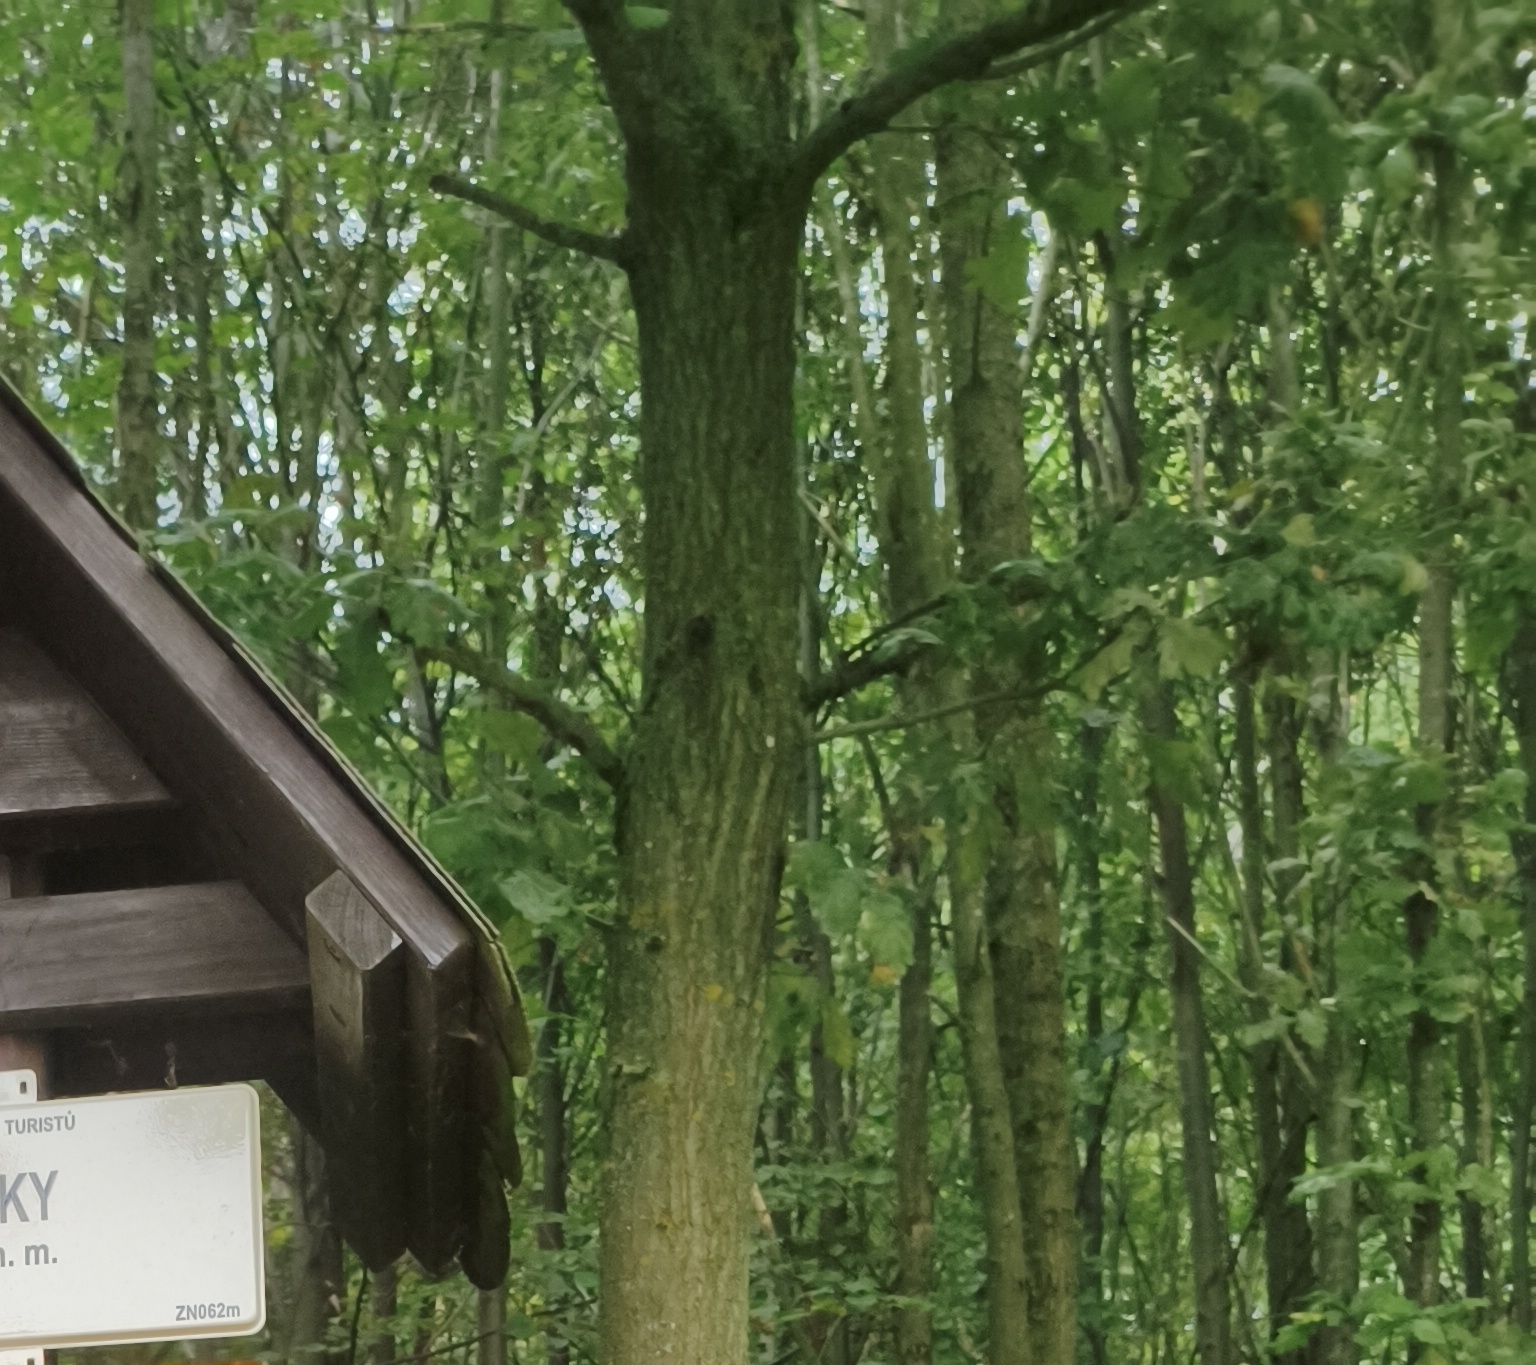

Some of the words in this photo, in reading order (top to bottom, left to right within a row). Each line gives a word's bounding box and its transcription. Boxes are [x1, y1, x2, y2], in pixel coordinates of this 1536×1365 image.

[5, 1110, 76, 1136] TURISTŮ
[25, 1243, 58, 1266] m.
[176, 1302, 240, 1322] ZN062m
